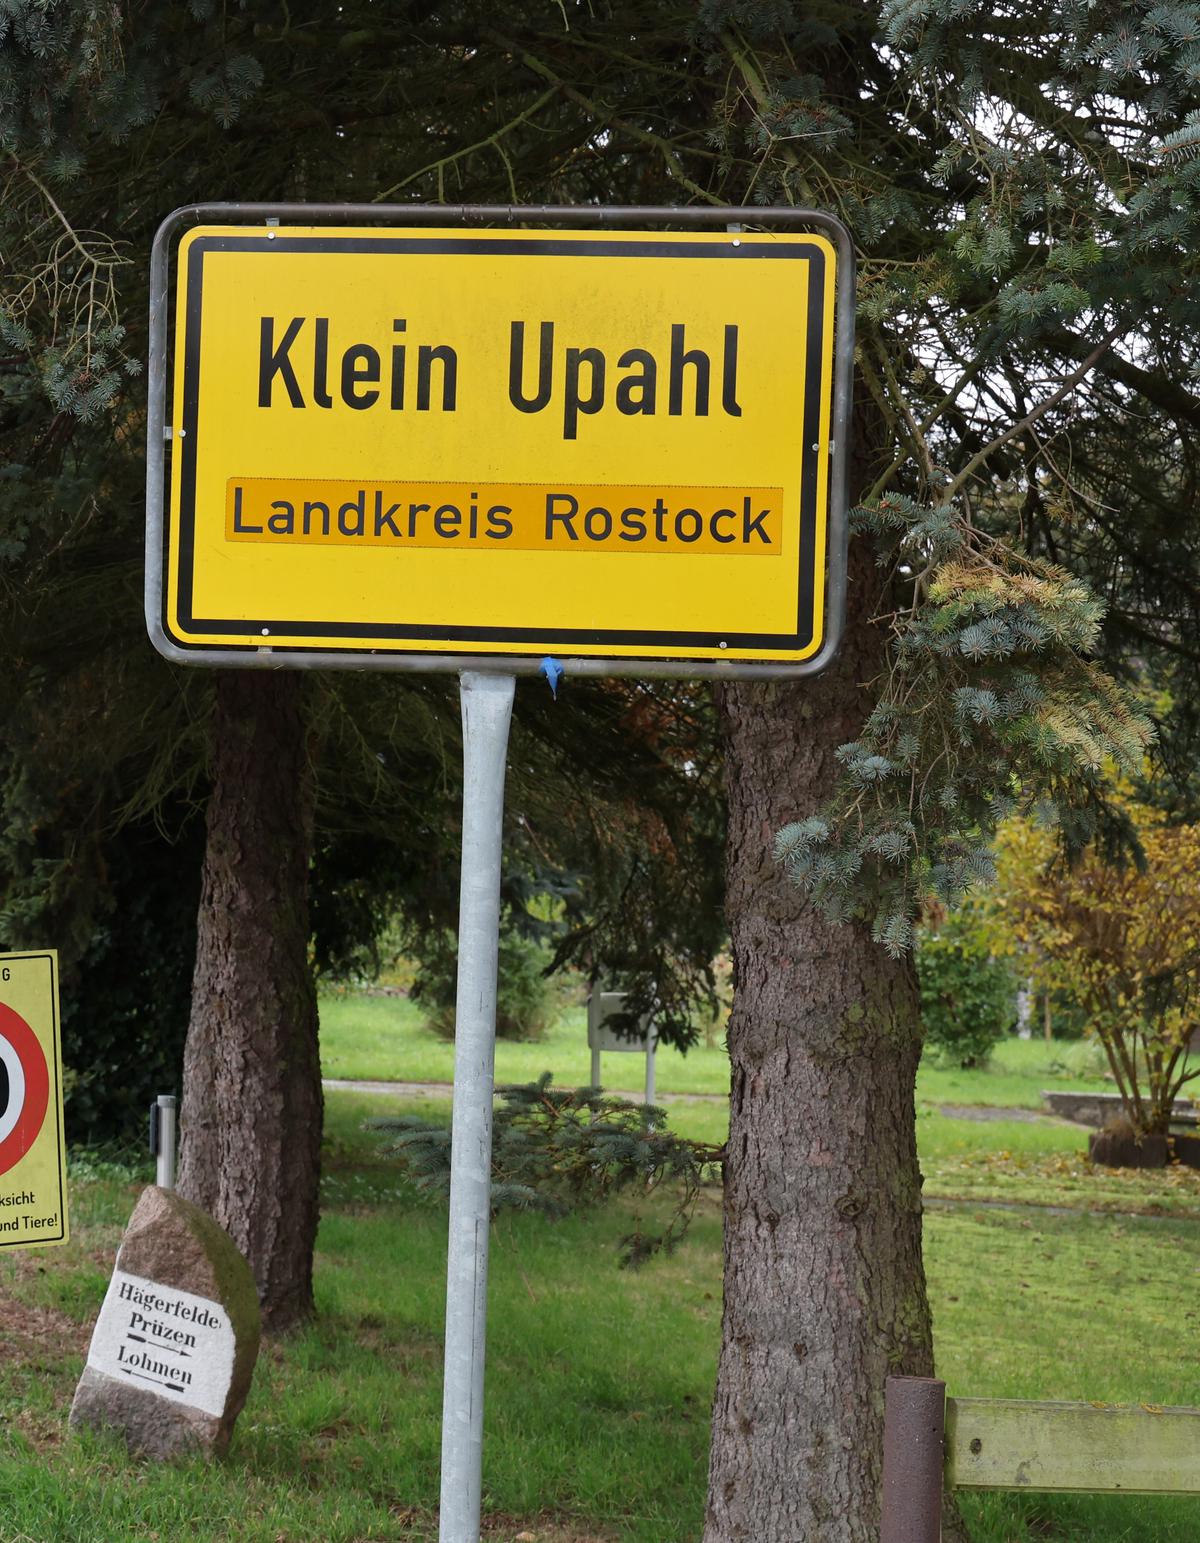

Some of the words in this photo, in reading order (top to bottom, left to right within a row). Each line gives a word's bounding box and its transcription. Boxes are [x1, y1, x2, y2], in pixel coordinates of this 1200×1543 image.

[258, 317, 458, 411] Klein
[508, 321, 742, 440] Upahl
[233, 487, 514, 540] Landkreis
[544, 494, 772, 544] Rostock
[22, 1212, 58, 1231] Tiere!
[129, 1312, 197, 1348] Prüzen
[117, 1346, 193, 1385] Lohmen
